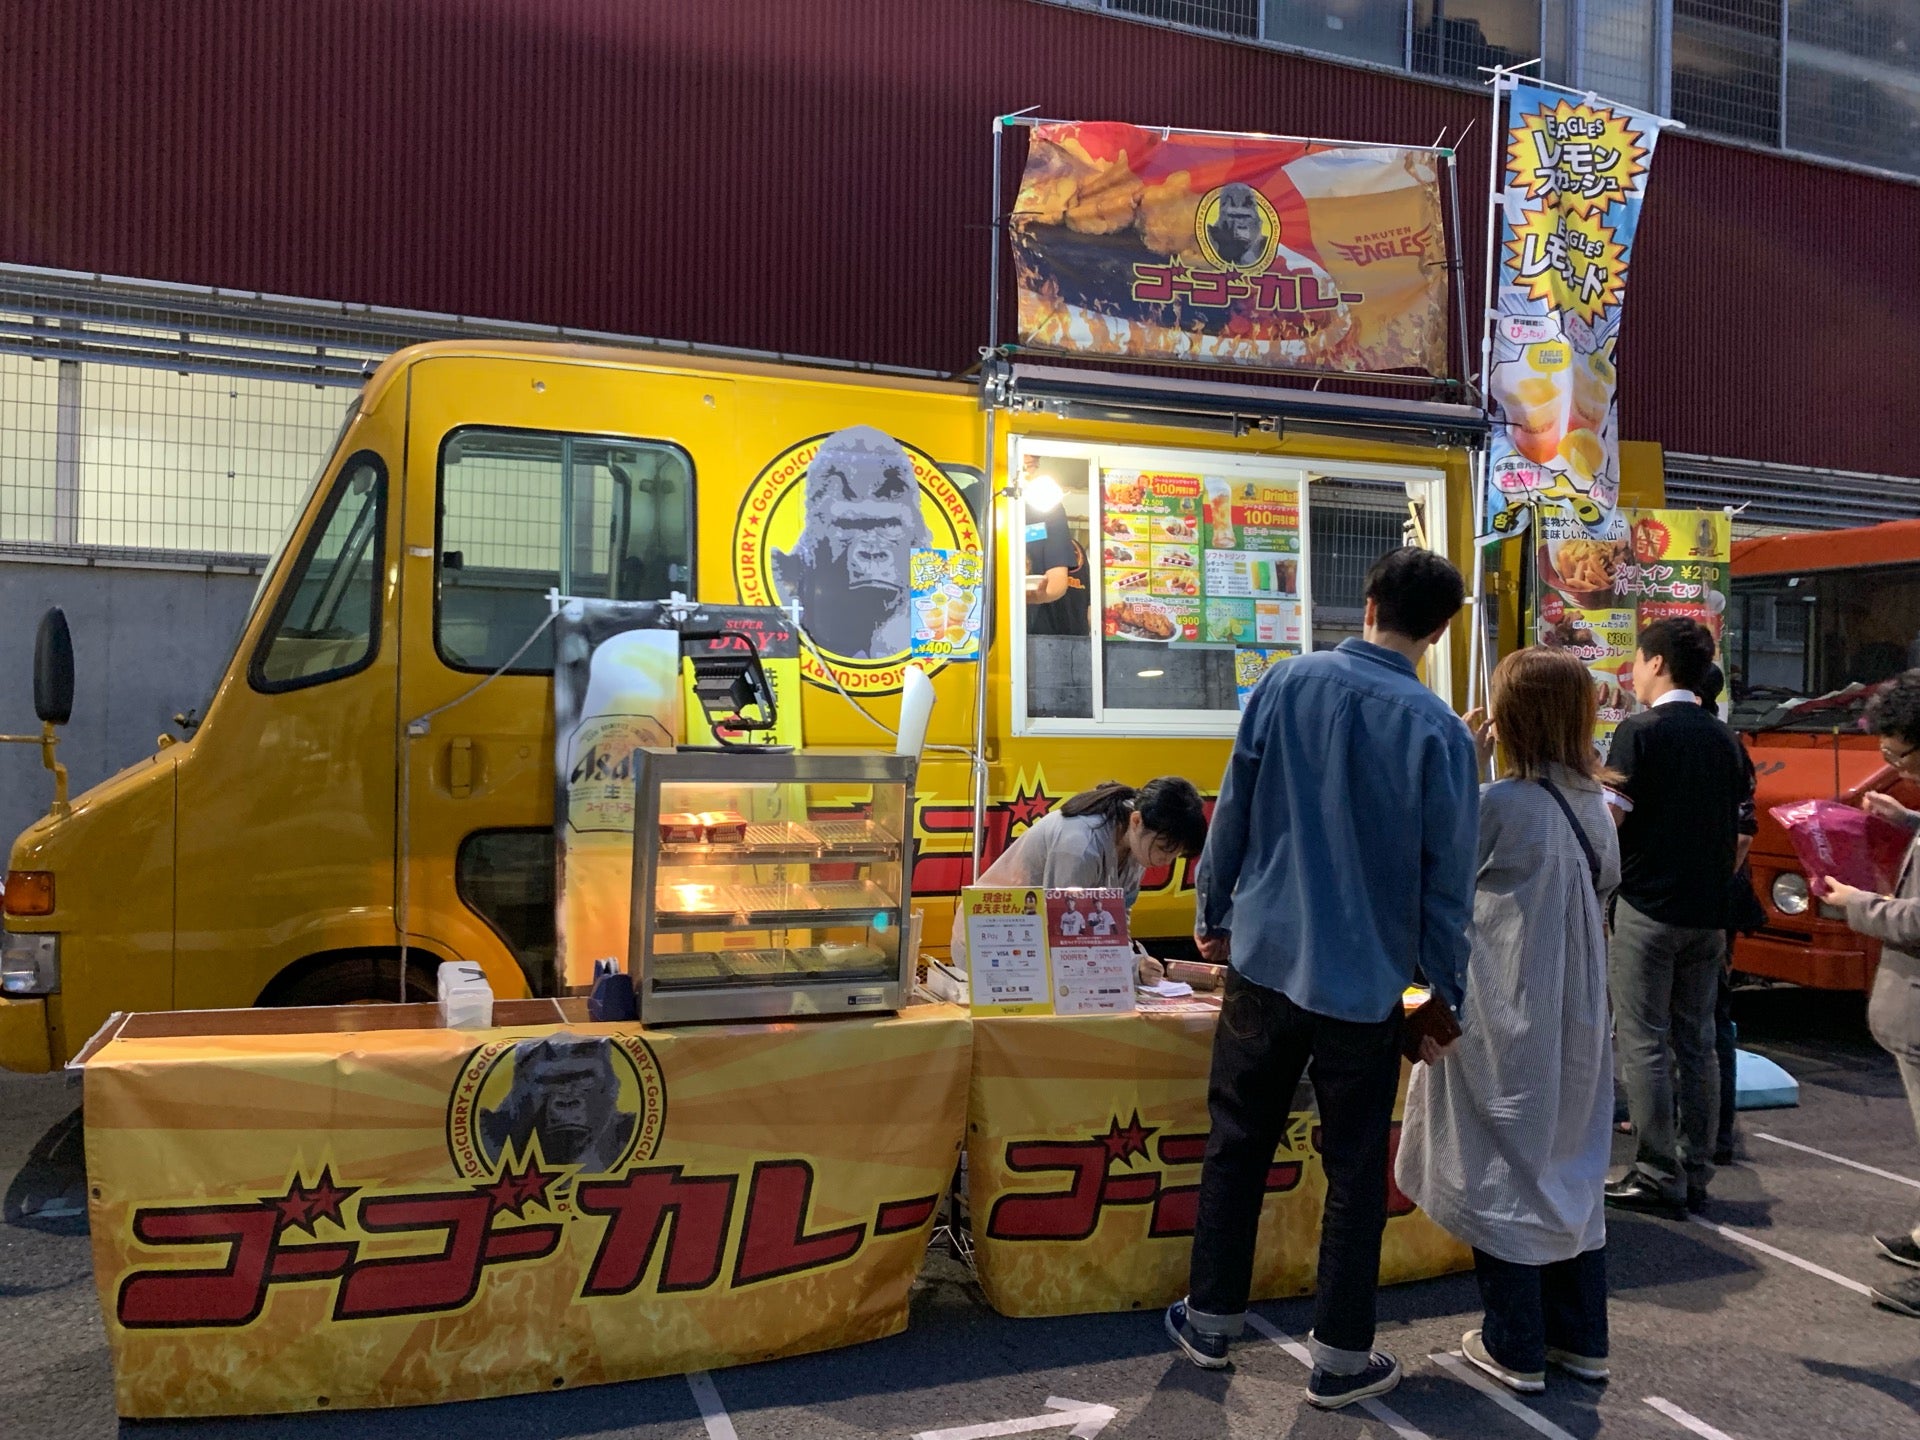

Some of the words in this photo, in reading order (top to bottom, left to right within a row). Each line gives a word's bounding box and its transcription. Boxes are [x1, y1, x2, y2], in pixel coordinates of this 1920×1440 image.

[1545, 115, 1604, 140] EAGLES
[1532, 131, 1620, 173] レモン
[1534, 169, 1619, 198] スカッシュ
[1355, 226, 1412, 243] RAKUTEN
[1344, 236, 1430, 266] EAGLES
[1133, 259, 1364, 312] ゴーゴーカレー
[1614, 564, 1674, 580] メットイン
[726, 619, 763, 629] SUPER
[1176, 616, 1199, 625] ¥900
[603, 784, 621, 799] 生
[982, 892, 1013, 903] 現金は
[1046, 891, 1062, 900] GO
[972, 903, 1021, 914] 使えません
[117, 1162, 938, 1329] ゴーゴーカレー
